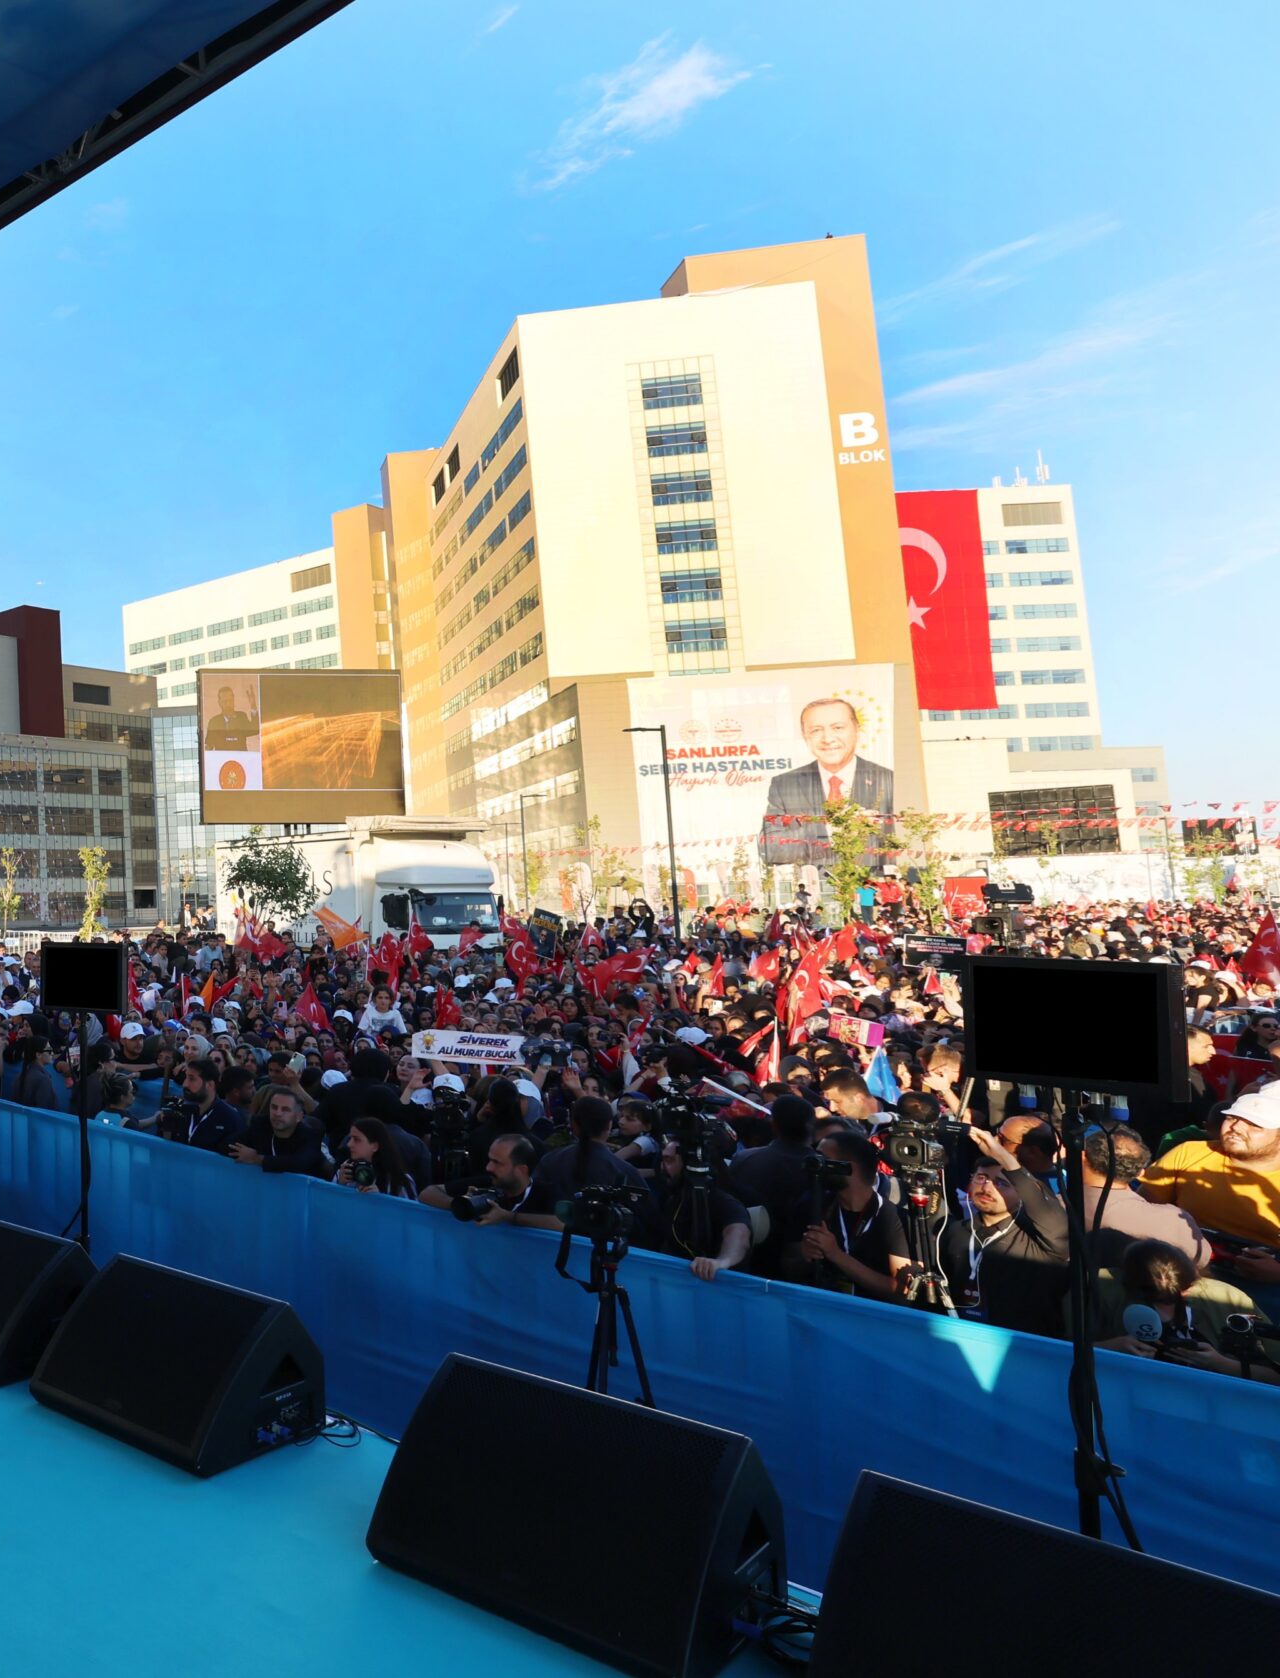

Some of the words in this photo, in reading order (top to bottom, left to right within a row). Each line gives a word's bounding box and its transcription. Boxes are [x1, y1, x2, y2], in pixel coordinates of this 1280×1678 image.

[839, 412, 879, 448] B
[838, 449, 886, 465] BLOK
[692, 758, 793, 775] HASTANESİ
[725, 768, 764, 787] Olsun
[457, 1035, 510, 1048] SİVEREK
[437, 1046, 454, 1056] ALİ
[454, 1049, 484, 1057] MURAT
[484, 1050, 517, 1060] BUCAK
